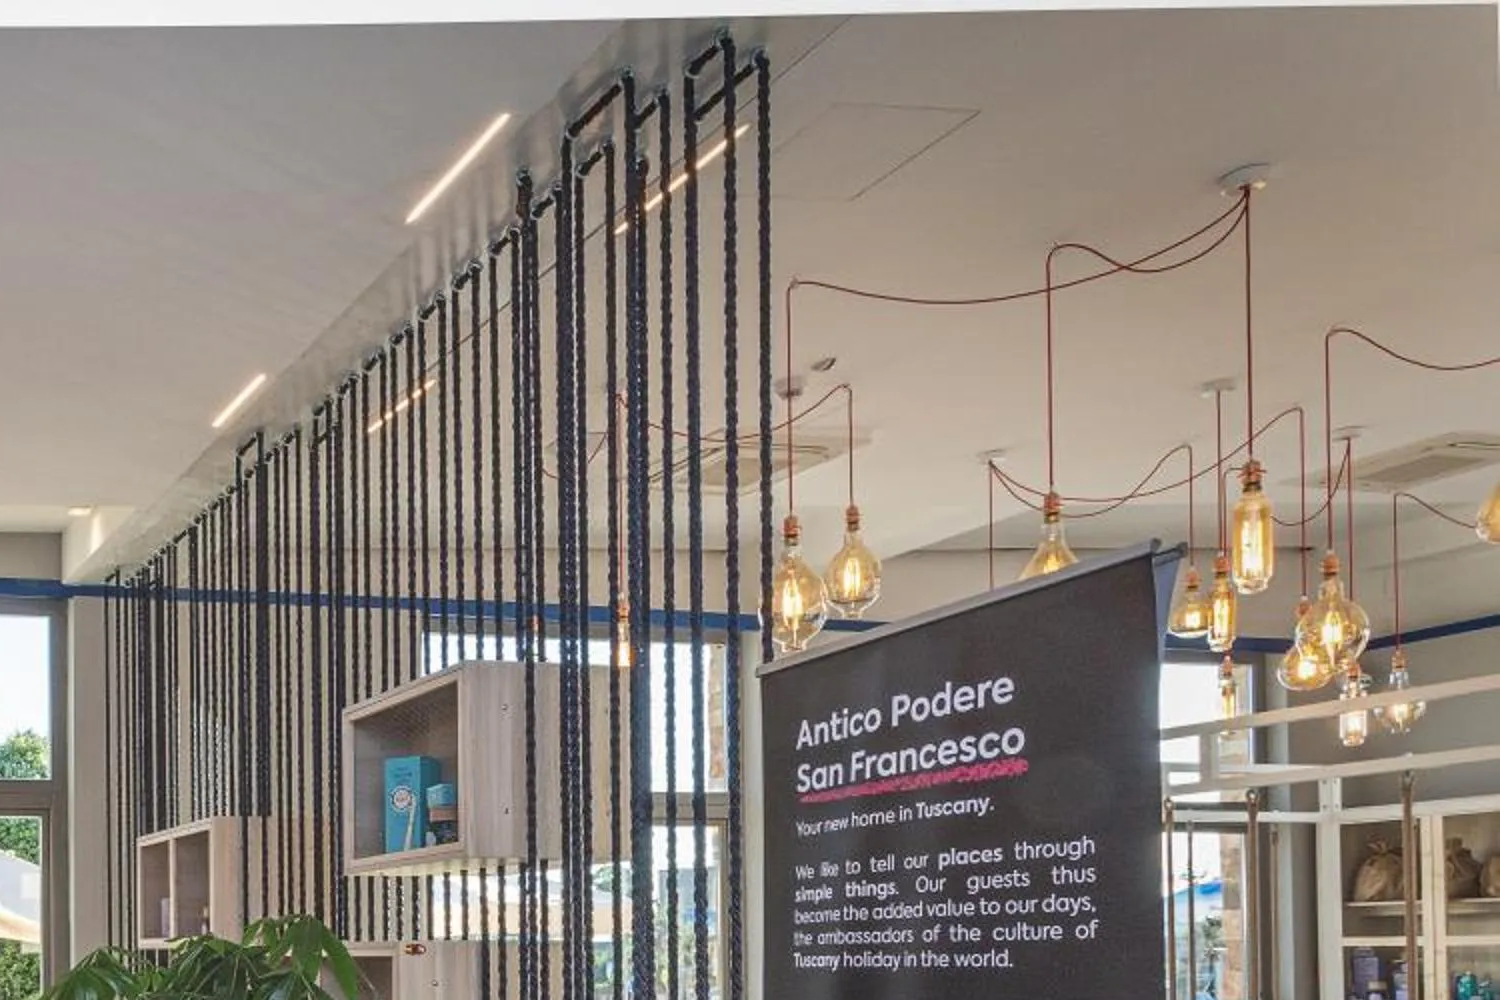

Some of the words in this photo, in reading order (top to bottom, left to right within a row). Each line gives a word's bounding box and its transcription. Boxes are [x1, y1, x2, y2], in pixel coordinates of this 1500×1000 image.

[796, 707, 881, 749] Antico
[892, 675, 1014, 728] Podere
[796, 762, 843, 794] San
[850, 727, 1024, 782] Francesco
[796, 817, 821, 836] Your
[824, 816, 848, 833] new
[852, 810, 895, 829] home
[900, 806, 912, 822] in
[917, 797, 994, 819] Tuscany.
[796, 864, 814, 880] We
[846, 859, 861, 875] to
[870, 855, 894, 873] tell
[904, 854, 929, 870] our
[938, 846, 1002, 870] places
[1015, 836, 1095, 861] through
[795, 884, 833, 904] simple
[846, 880, 898, 902] things.
[916, 876, 946, 893] Our
[967, 871, 1029, 894] guests
[1052, 866, 1096, 883] thus
[794, 907, 840, 925] become
[843, 904, 868, 921] the
[872, 900, 922, 919] added
[927, 899, 975, 917] value
[980, 899, 999, 916] to
[1005, 899, 1035, 913] our
[794, 930, 812, 945] the
[818, 927, 913, 943] ambassadors
[923, 925, 938, 942] of
[950, 925, 980, 941] the
[993, 923, 1063, 940] culture
[1075, 920, 1099, 939] of
[794, 952, 839, 971] Tuscany
[843, 951, 900, 971] holiday
[904, 951, 917, 966] in
[921, 950, 948, 967] the
[954, 949, 1012, 968] world.
